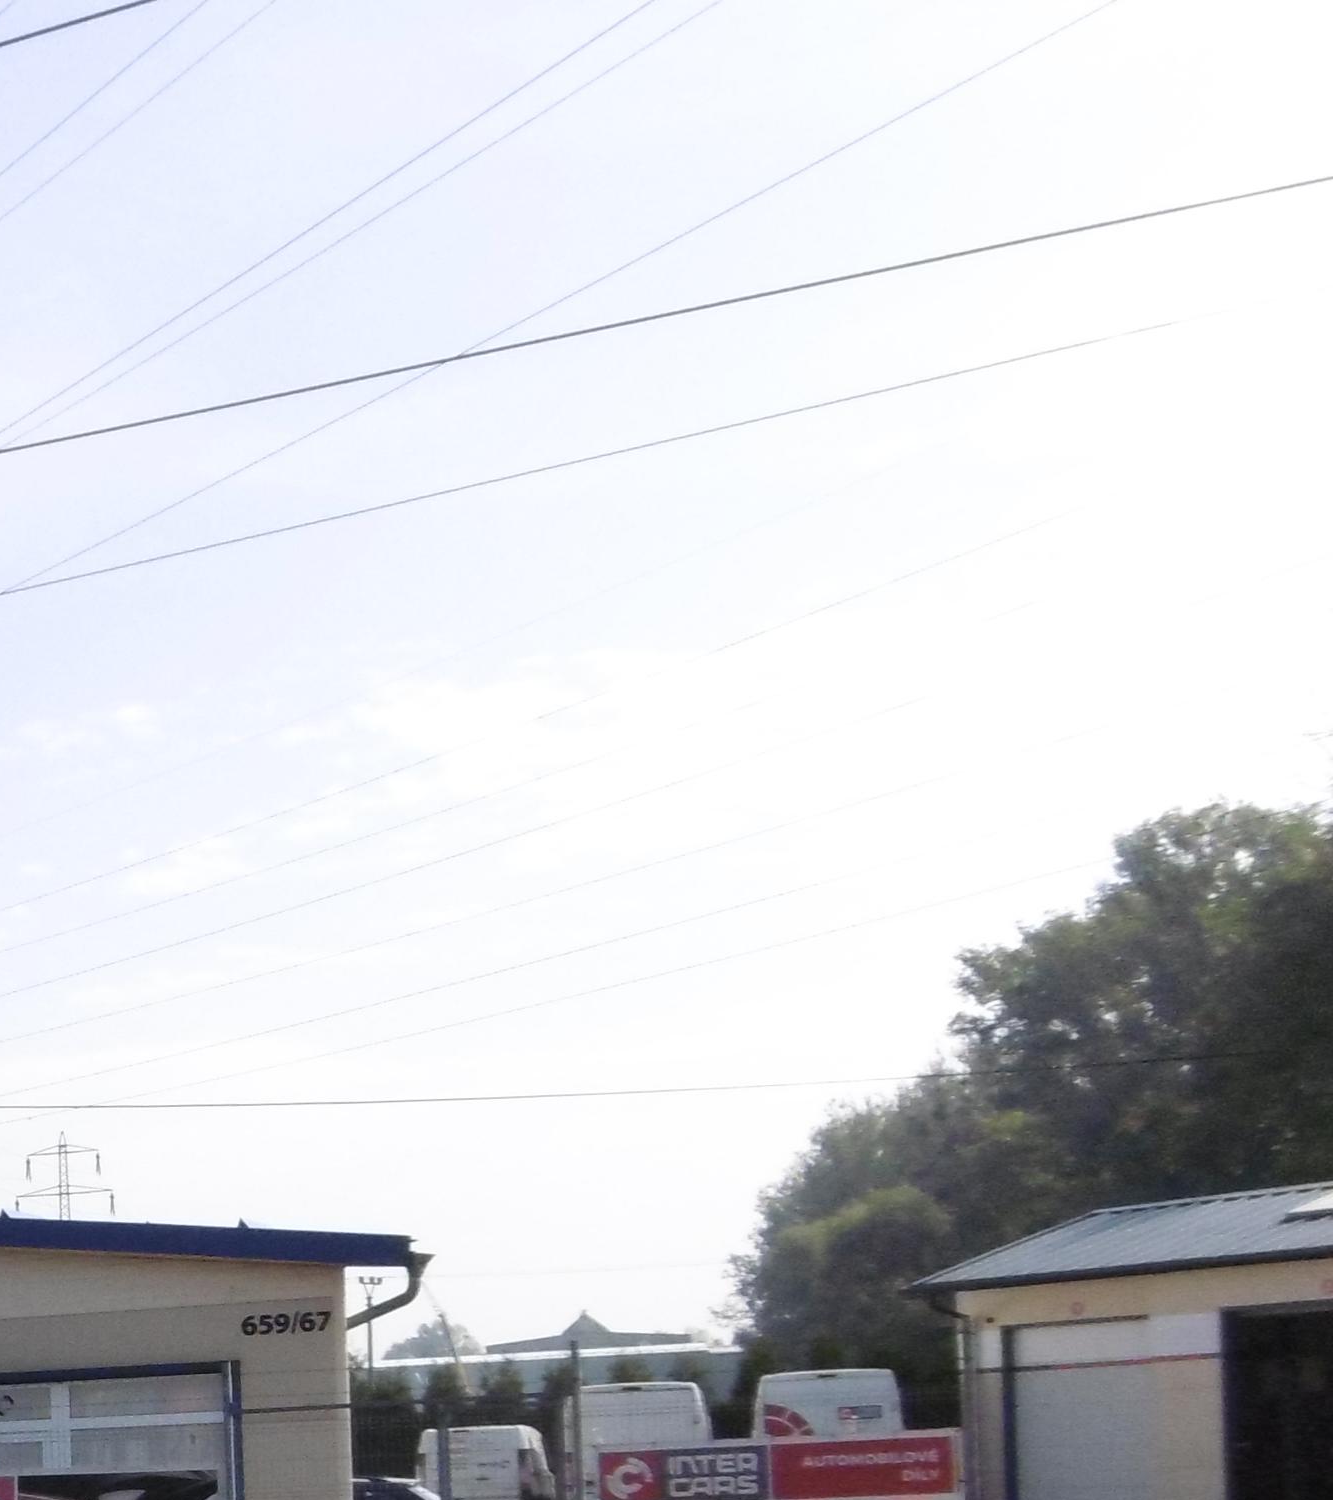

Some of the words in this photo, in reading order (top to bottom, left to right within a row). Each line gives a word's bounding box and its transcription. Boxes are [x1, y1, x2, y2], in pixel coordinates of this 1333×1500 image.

[240, 1310, 332, 1336] 659/67
[668, 1452, 758, 1476] INTER
[669, 1475, 759, 1498] CARS
